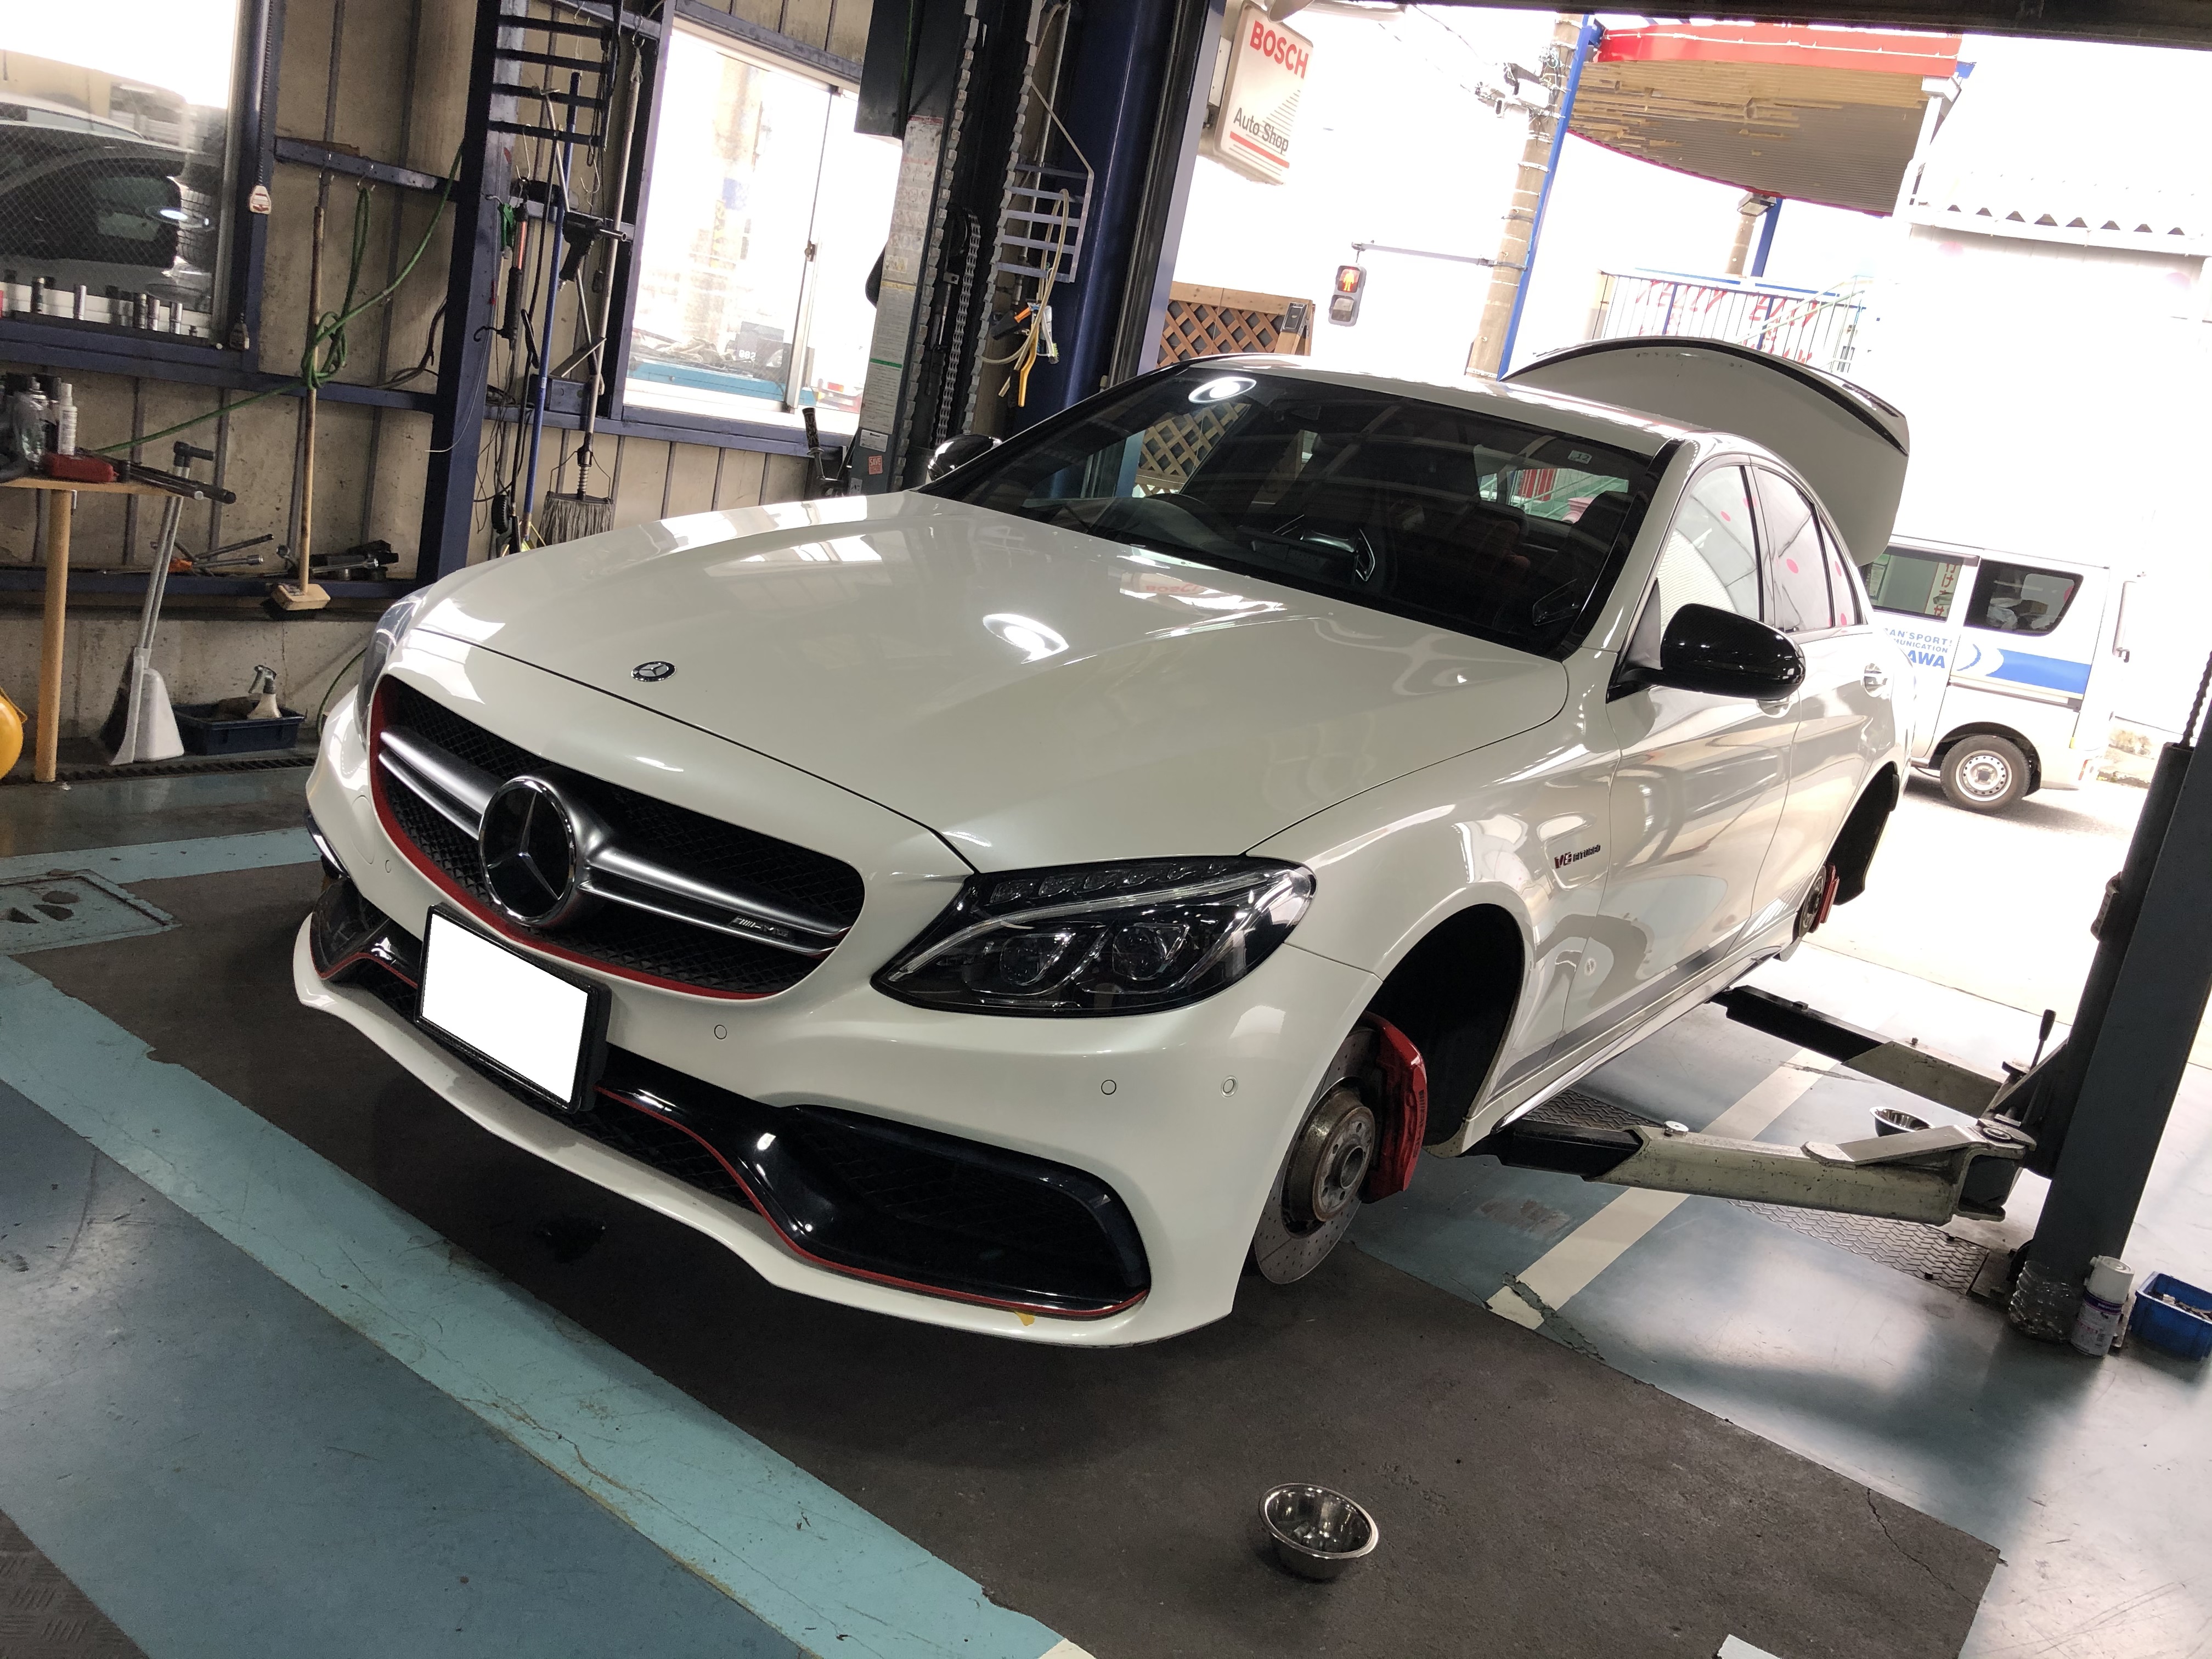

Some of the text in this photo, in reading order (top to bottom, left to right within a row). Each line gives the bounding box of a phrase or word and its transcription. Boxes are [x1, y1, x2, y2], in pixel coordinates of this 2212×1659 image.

[1250, 20, 1308, 80] BOSCH
[1233, 108, 1289, 155] Auto Shop
[870, 458, 882, 466] SAVE
[1884, 628, 1948, 645] ANSPORT
[1554, 851, 1572, 869] V8
